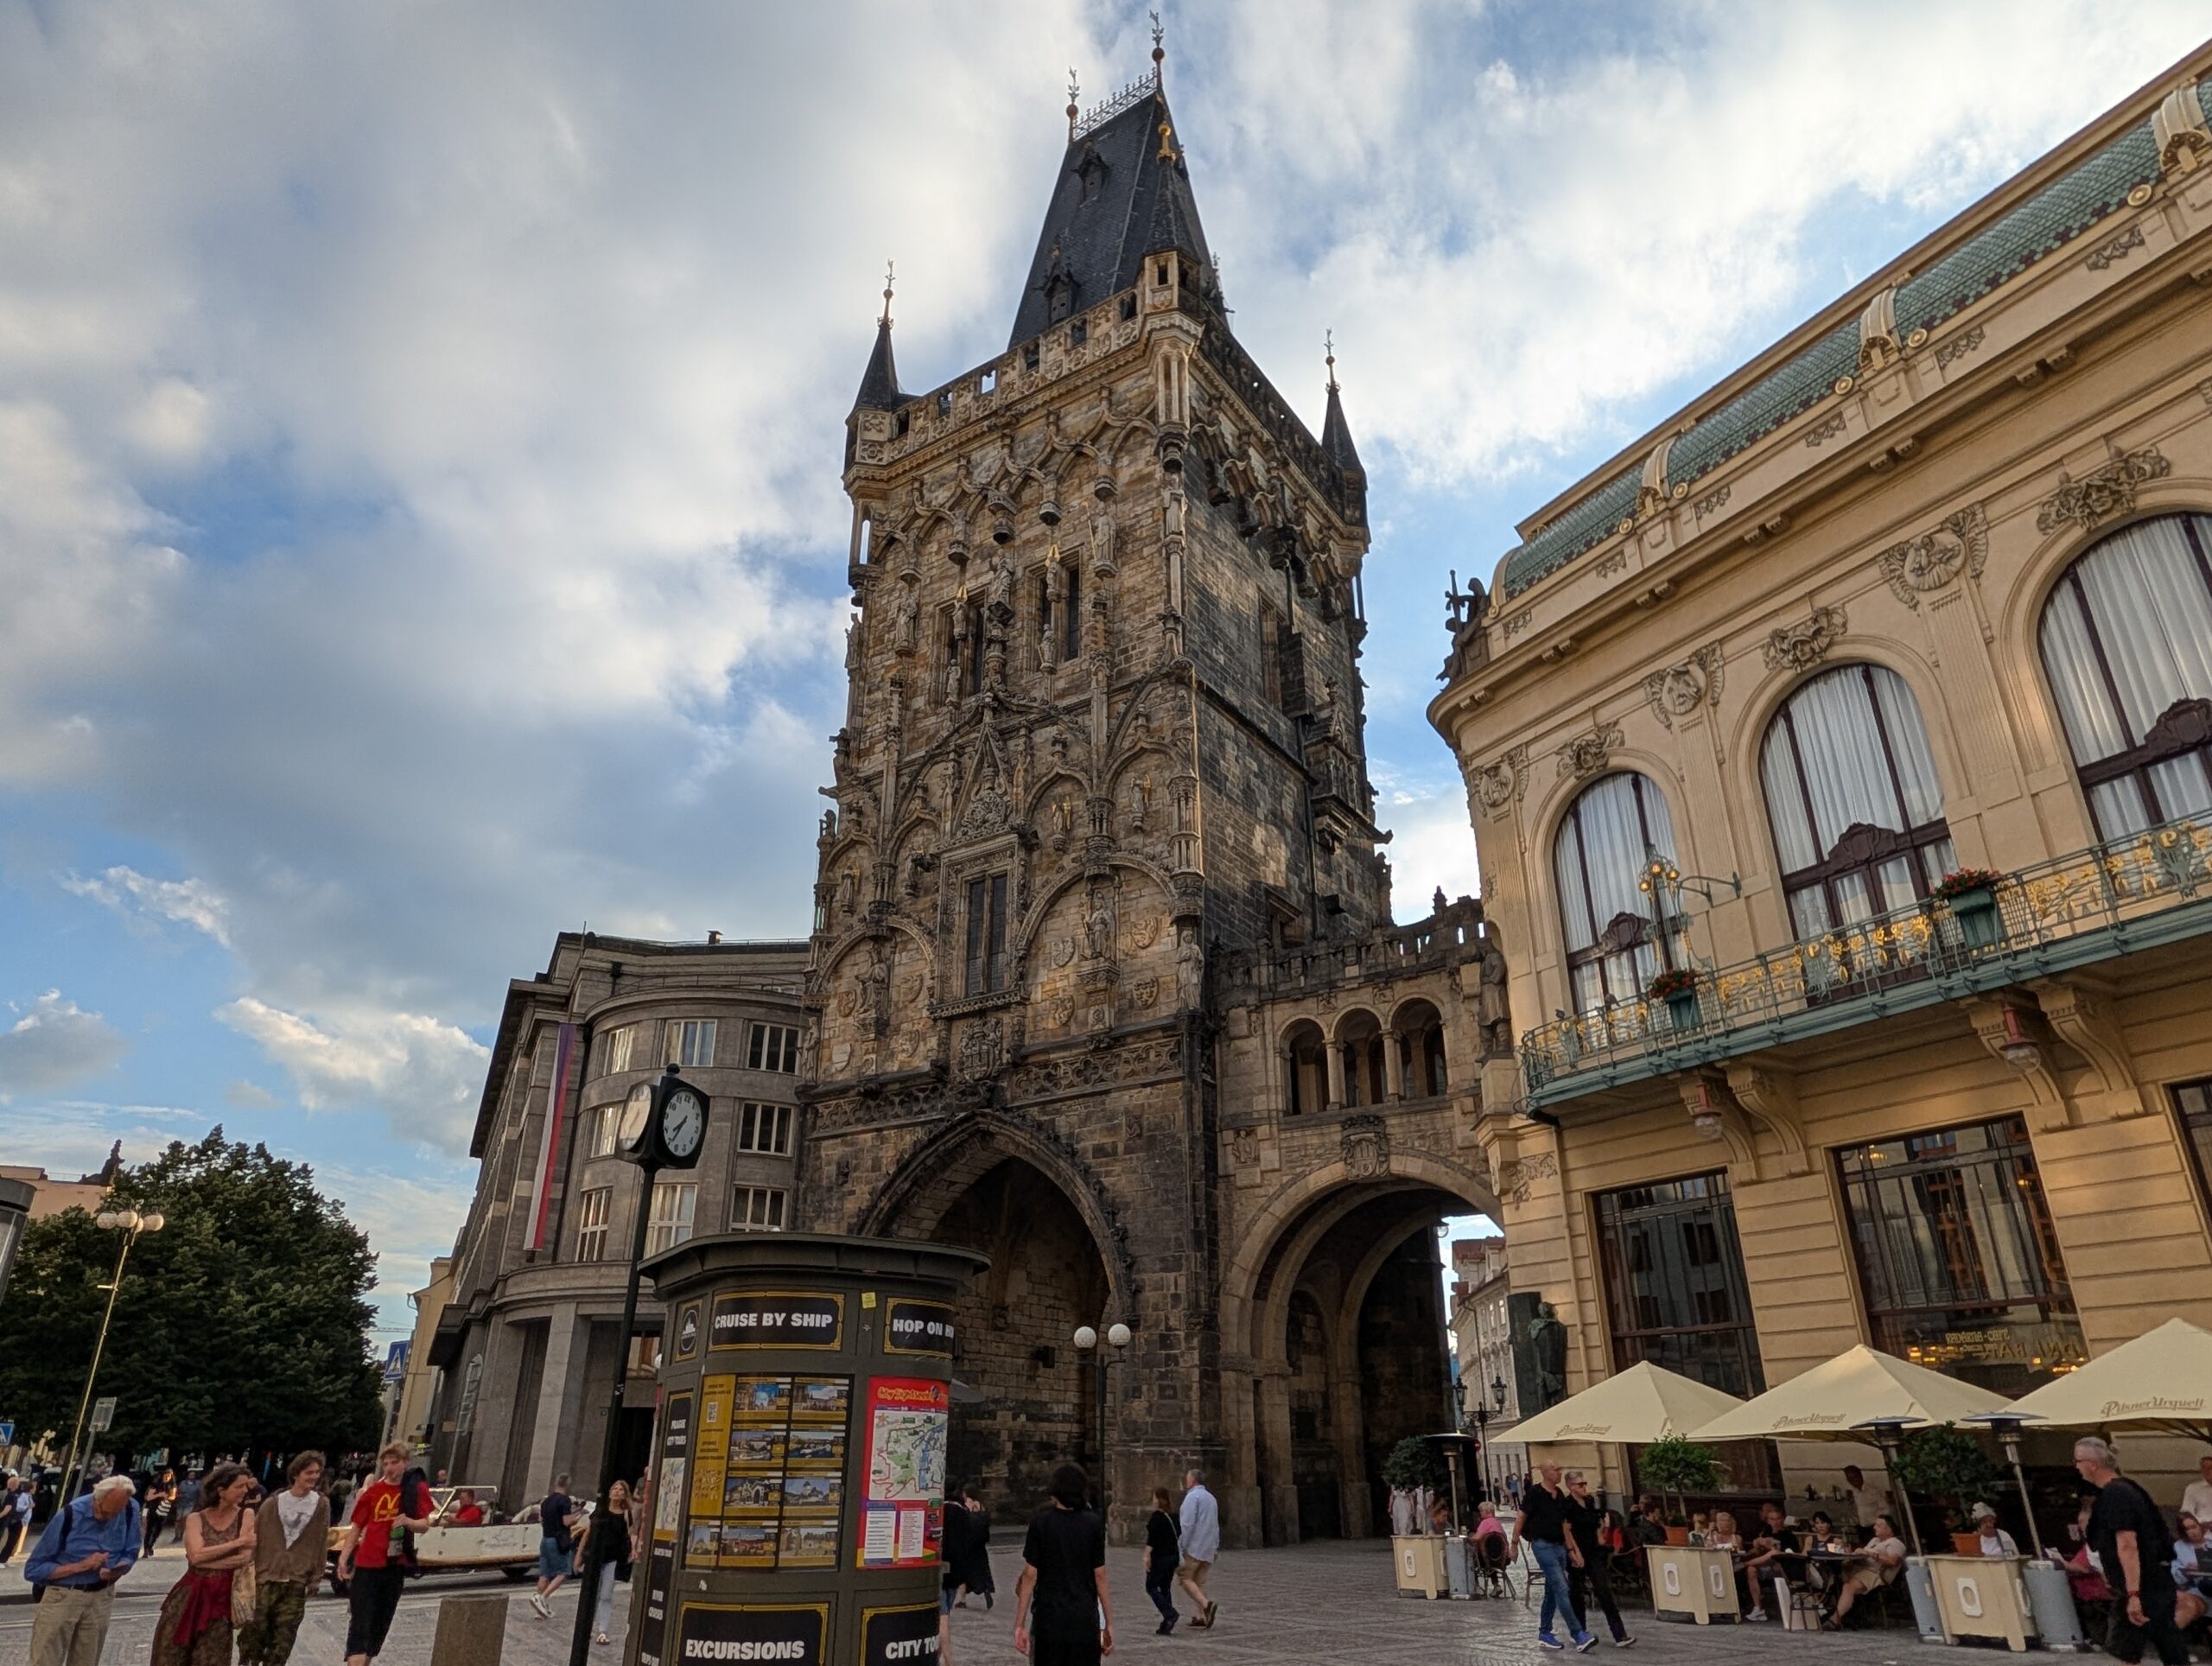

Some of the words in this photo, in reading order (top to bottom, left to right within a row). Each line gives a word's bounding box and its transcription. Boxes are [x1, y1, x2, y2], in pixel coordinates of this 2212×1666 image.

[715, 1313, 758, 1329] CRUISE
[762, 1313, 786, 1326] BY
[791, 1313, 833, 1328] SHIP
[893, 1319, 925, 1333] HOP
[927, 1321, 943, 1336] ON
[685, 1639, 804, 1660] EXCURSIONS
[885, 1639, 922, 1659] CITY
